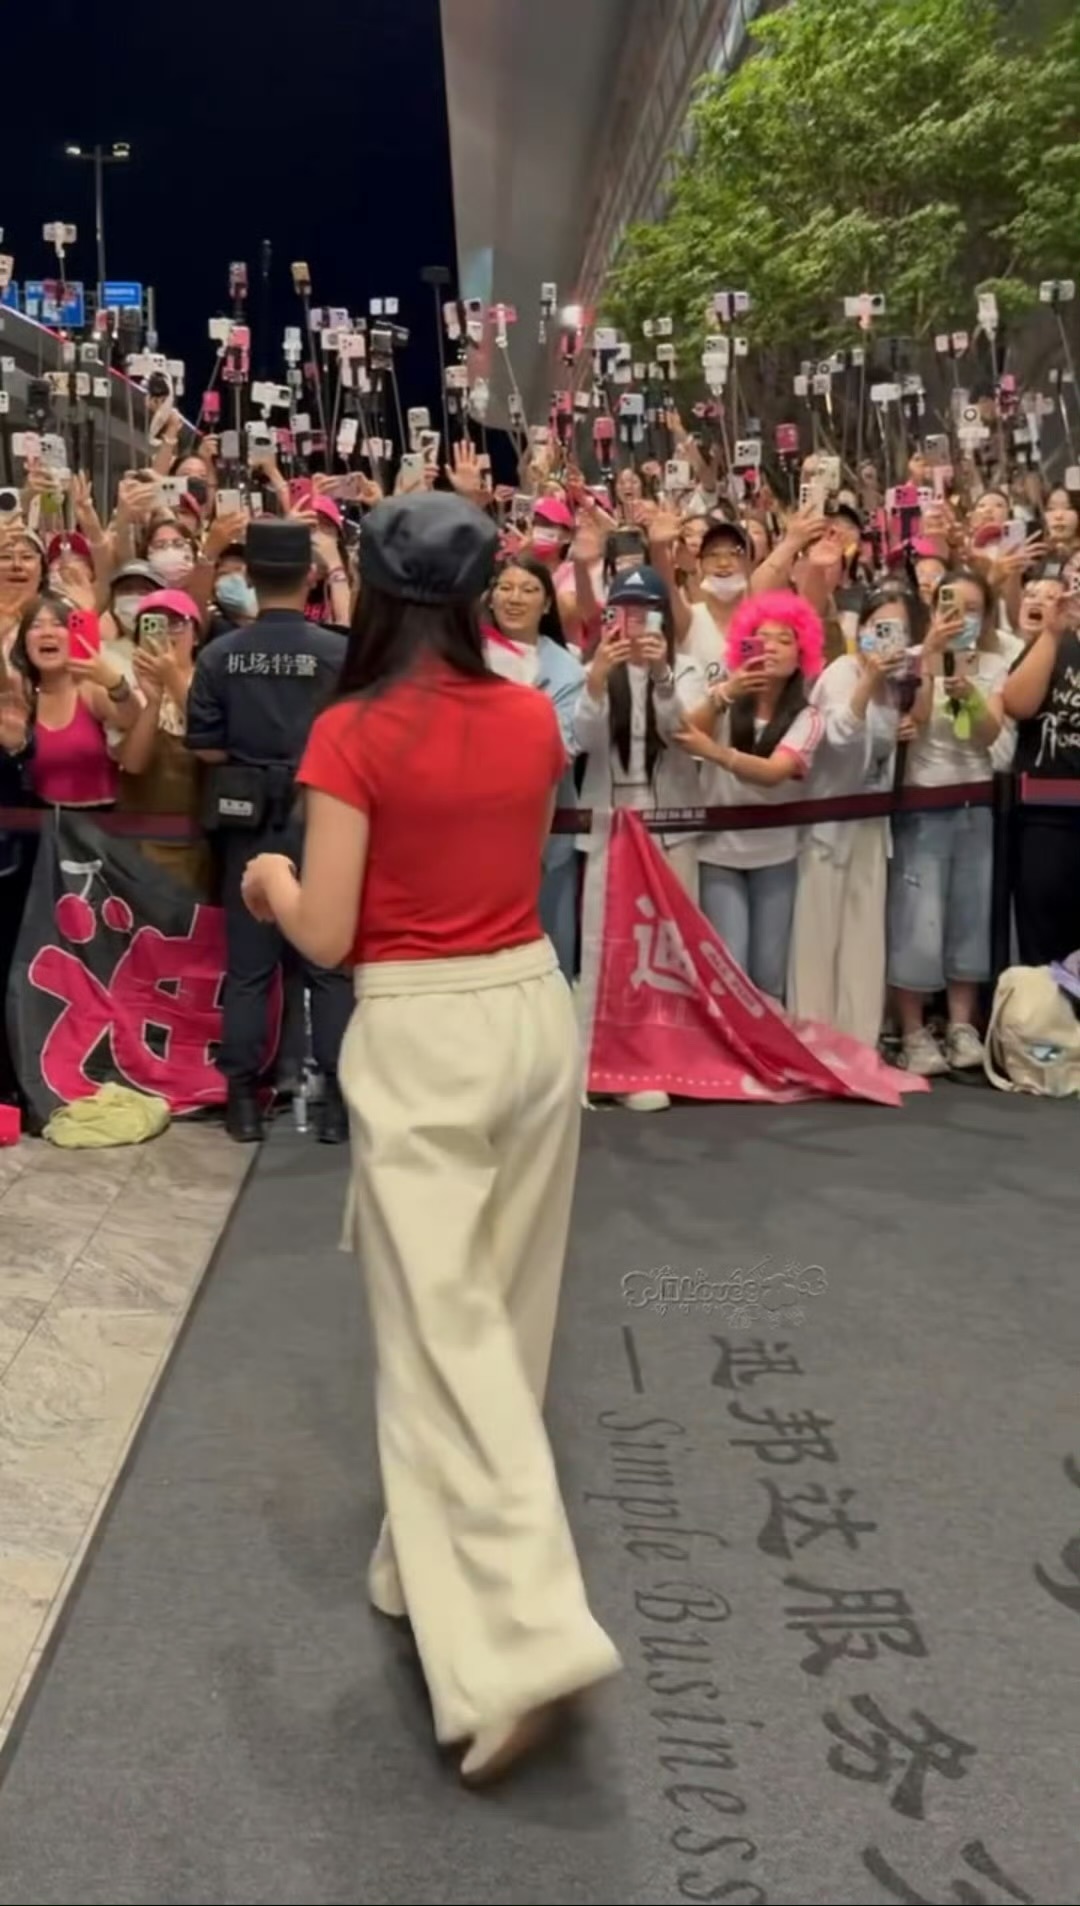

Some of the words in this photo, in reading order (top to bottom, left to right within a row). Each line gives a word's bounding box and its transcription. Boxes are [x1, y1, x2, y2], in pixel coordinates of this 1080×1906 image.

[227, 652, 318, 677] 机场特警
[583, 1409, 732, 1564] Simple
